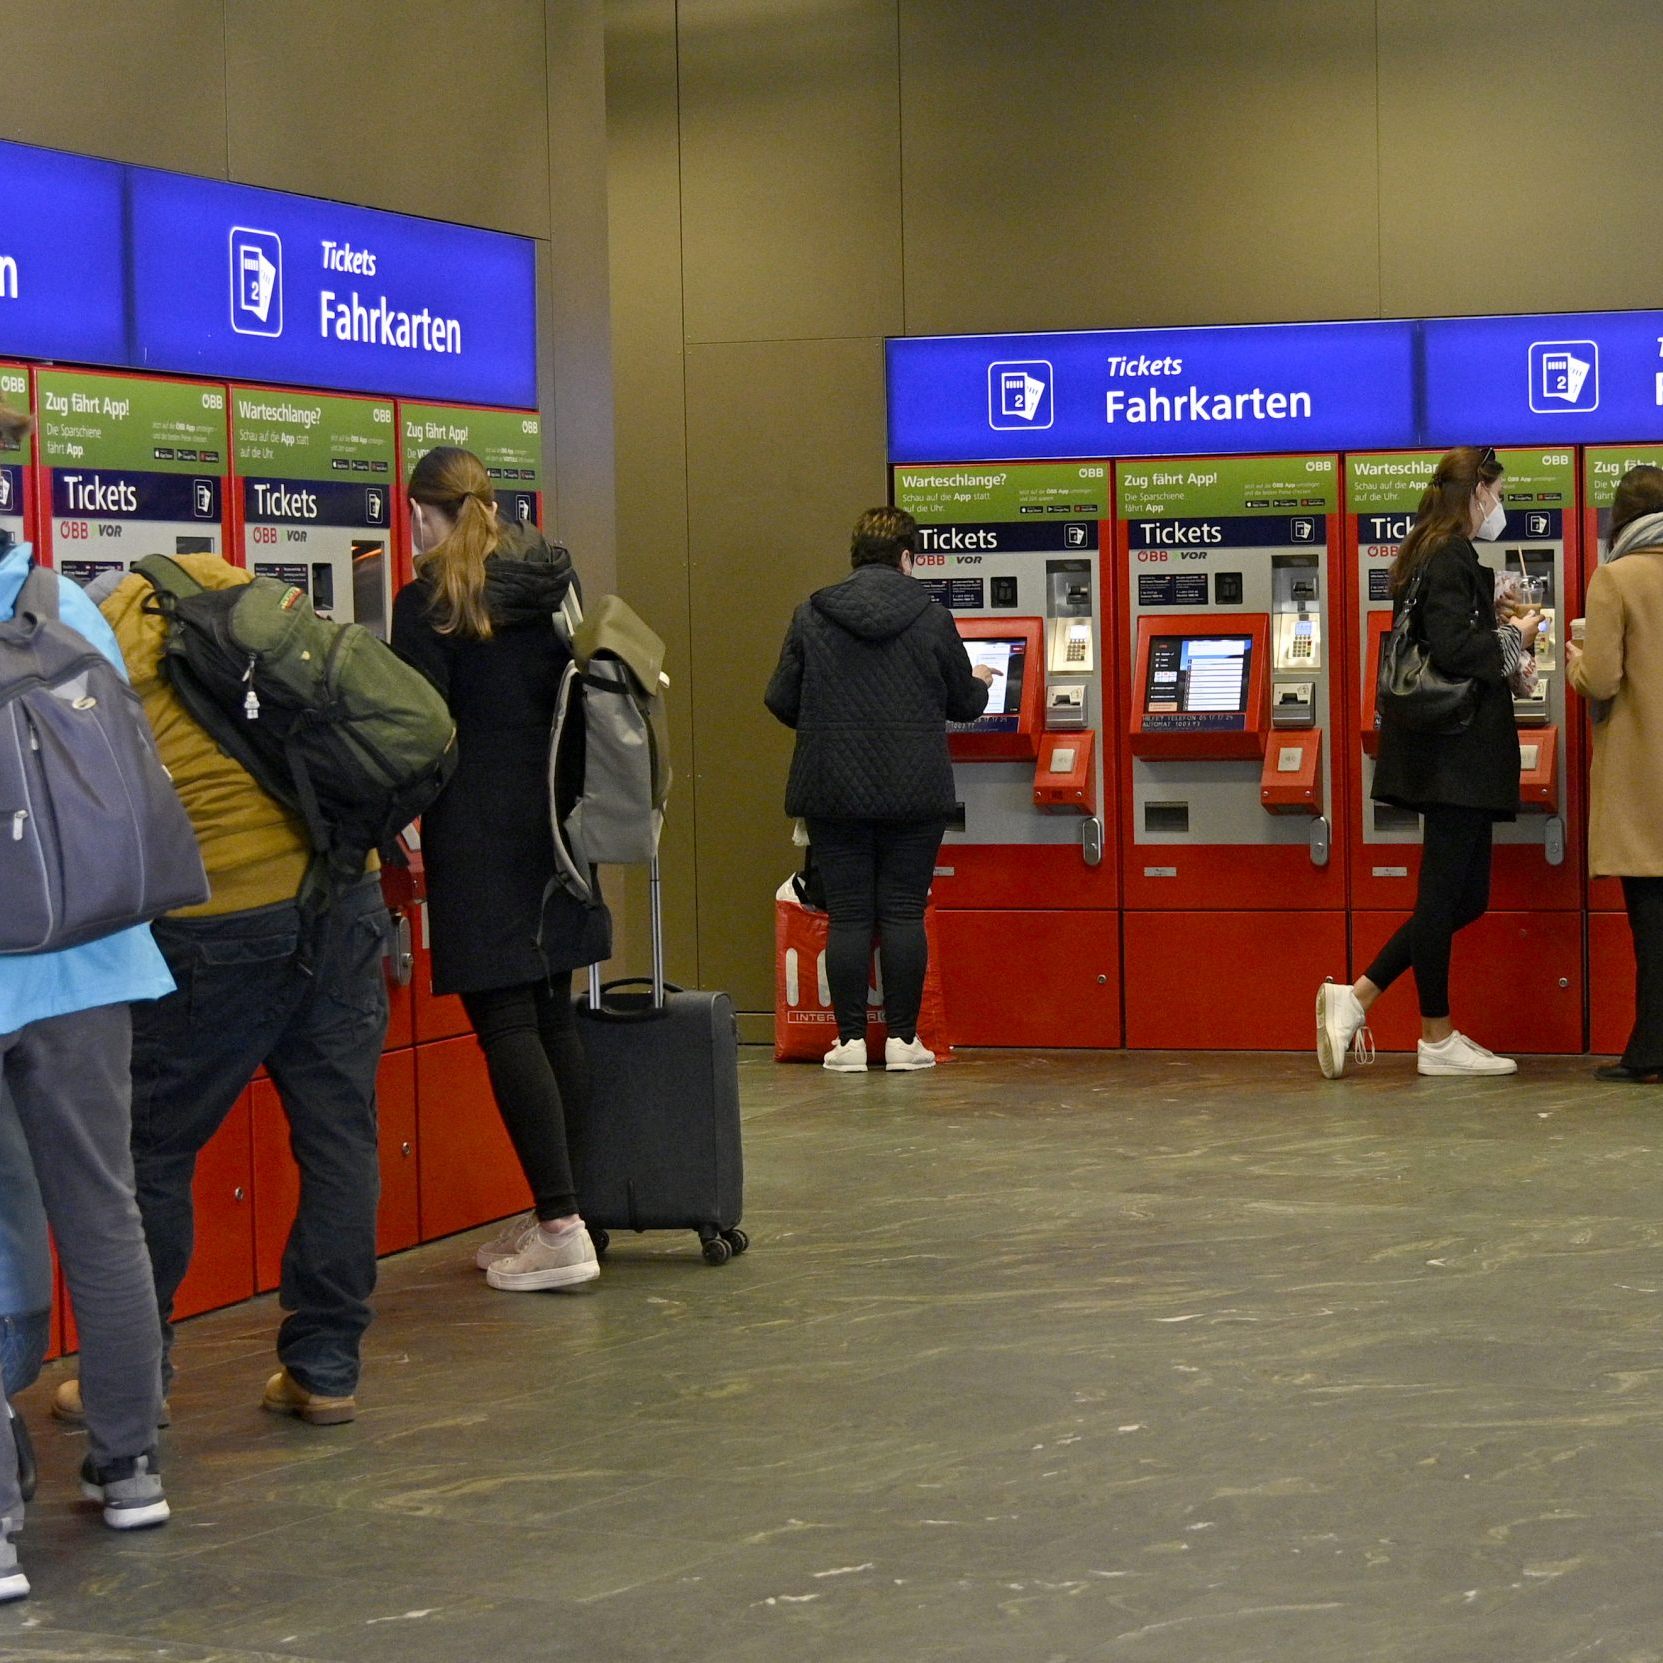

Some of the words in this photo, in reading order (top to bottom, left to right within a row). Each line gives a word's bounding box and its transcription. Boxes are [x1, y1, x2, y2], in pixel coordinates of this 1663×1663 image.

[321, 240, 376, 277] Tickets
[320, 290, 462, 354] Fahrkarten
[1107, 355, 1182, 377] Tickets
[1, 376, 25, 393] ÖBB
[46, 392, 67, 416] Zug
[72, 393, 100, 414] fährt
[103, 396, 130, 420] App!
[202, 394, 222, 409] ÖBB
[1106, 386, 1312, 424] Fahrkarten
[239, 400, 321, 429] Warteschlange?
[373, 408, 391, 423] ÖBB
[47, 423, 59, 436] Die
[61, 424, 101, 439] Sparschiene
[406, 422, 423, 442] Zug
[426, 422, 446, 440] fährt
[449, 425, 468, 445] App!
[522, 420, 538, 434] ÖBB
[240, 429, 258, 442] Schau
[259, 431, 269, 442] auf
[270, 431, 280, 443] die
[280, 432, 295, 446] App
[48, 441, 65, 454] fährt
[240, 447, 250, 458] auf
[252, 447, 261, 458] die
[1306, 461, 1332, 472] ÖBB
[1542, 455, 1568, 466] ÖBB
[1079, 467, 1104, 478] ÖBB
[1594, 462, 1619, 476] Zug
[902, 473, 1006, 489] Warteschlange?
[1124, 475, 1148, 489] Zug
[1152, 473, 1183, 485] fährt
[1188, 472, 1217, 487] App!
[1354, 481, 1377, 491] Schau
[1380, 481, 1392, 489] auf
[1395, 480, 1407, 488] die
[1409, 480, 1428, 490] App
[1594, 480, 1607, 489] Die
[64, 476, 137, 512] Tickets
[254, 483, 318, 518] Tickets
[902, 494, 924, 502] Schau
[926, 493, 938, 501] auf
[940, 492, 952, 501] die
[954, 492, 971, 502] App
[1124, 493, 1137, 501] Die
[1140, 492, 1184, 502] Sparschiene
[1355, 493, 1367, 502] auf
[1370, 493, 1381, 501] die
[1125, 504, 1143, 512] fährt
[60, 520, 88, 540] ÖBB
[98, 524, 122, 538] VOR
[253, 526, 277, 544] ÖBB
[286, 530, 307, 542] VOR
[1140, 521, 1222, 544] Tickets
[1370, 516, 1415, 539] Tick
[919, 528, 998, 550] Tickets
[1138, 550, 1168, 562] ÖBB
[1181, 552, 1207, 560] VOR
[1368, 546, 1399, 557] ÖBB
[916, 555, 945, 566] ÖBB
[956, 556, 982, 564] VOR
